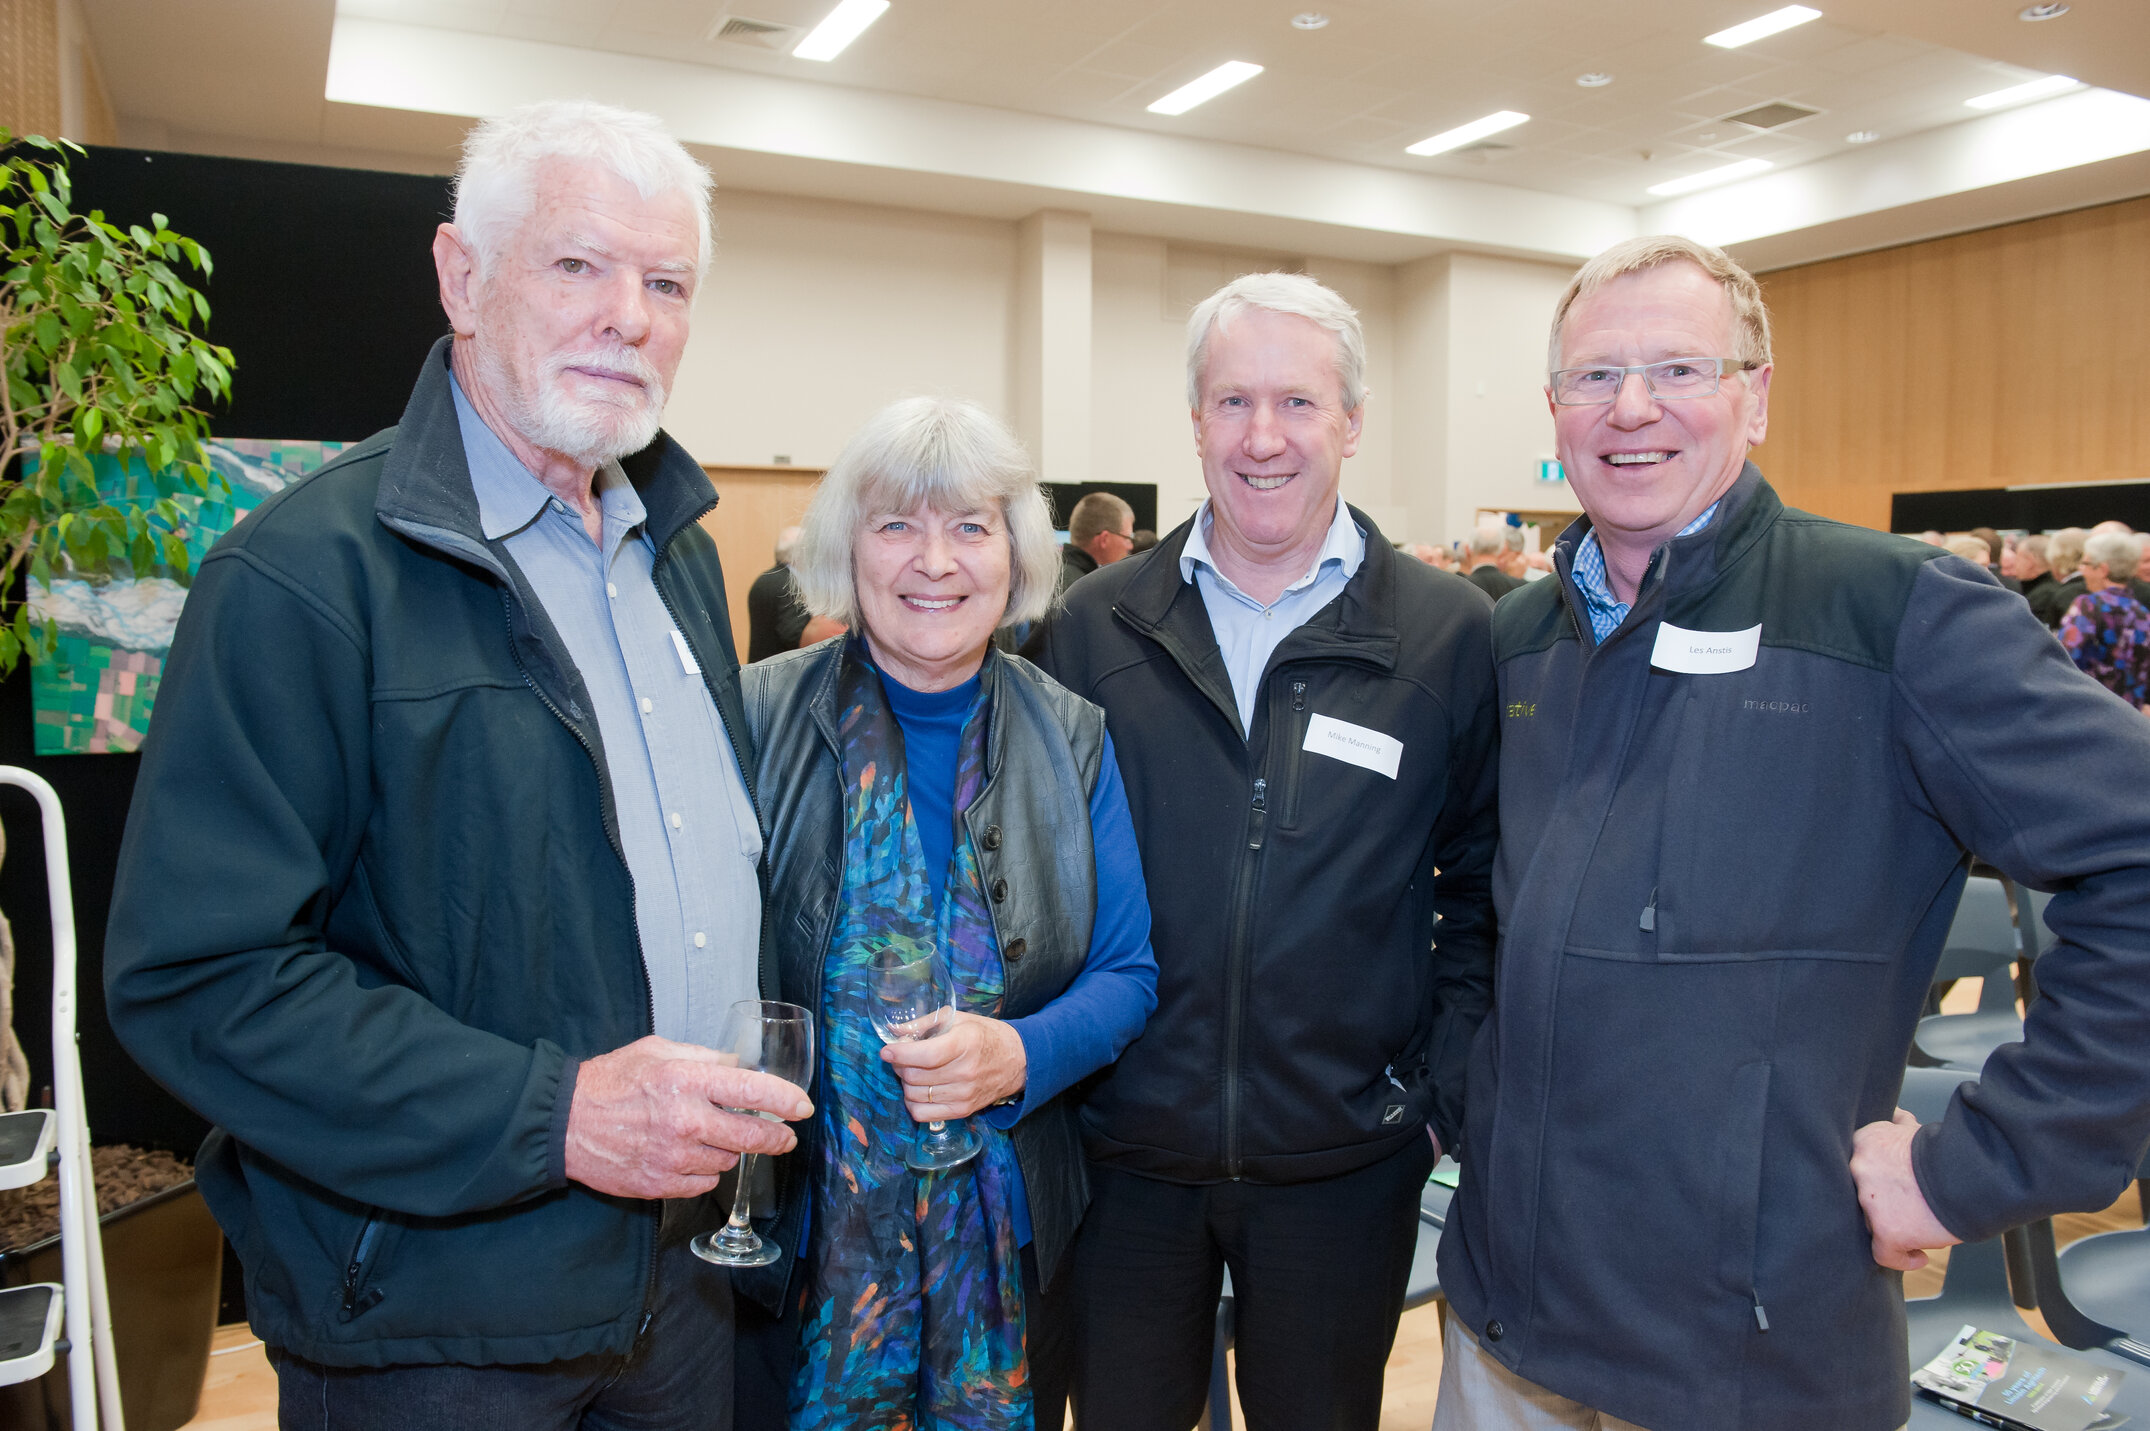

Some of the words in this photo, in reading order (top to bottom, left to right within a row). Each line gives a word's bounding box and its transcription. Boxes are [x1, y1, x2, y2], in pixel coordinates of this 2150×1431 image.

[1689, 646, 1704, 654] Les
[1706, 647, 1732, 655] Anstis
[1743, 699, 1810, 713] macpac
[1327, 731, 1347, 743] Mike
[1348, 737, 1381, 755] Manning
